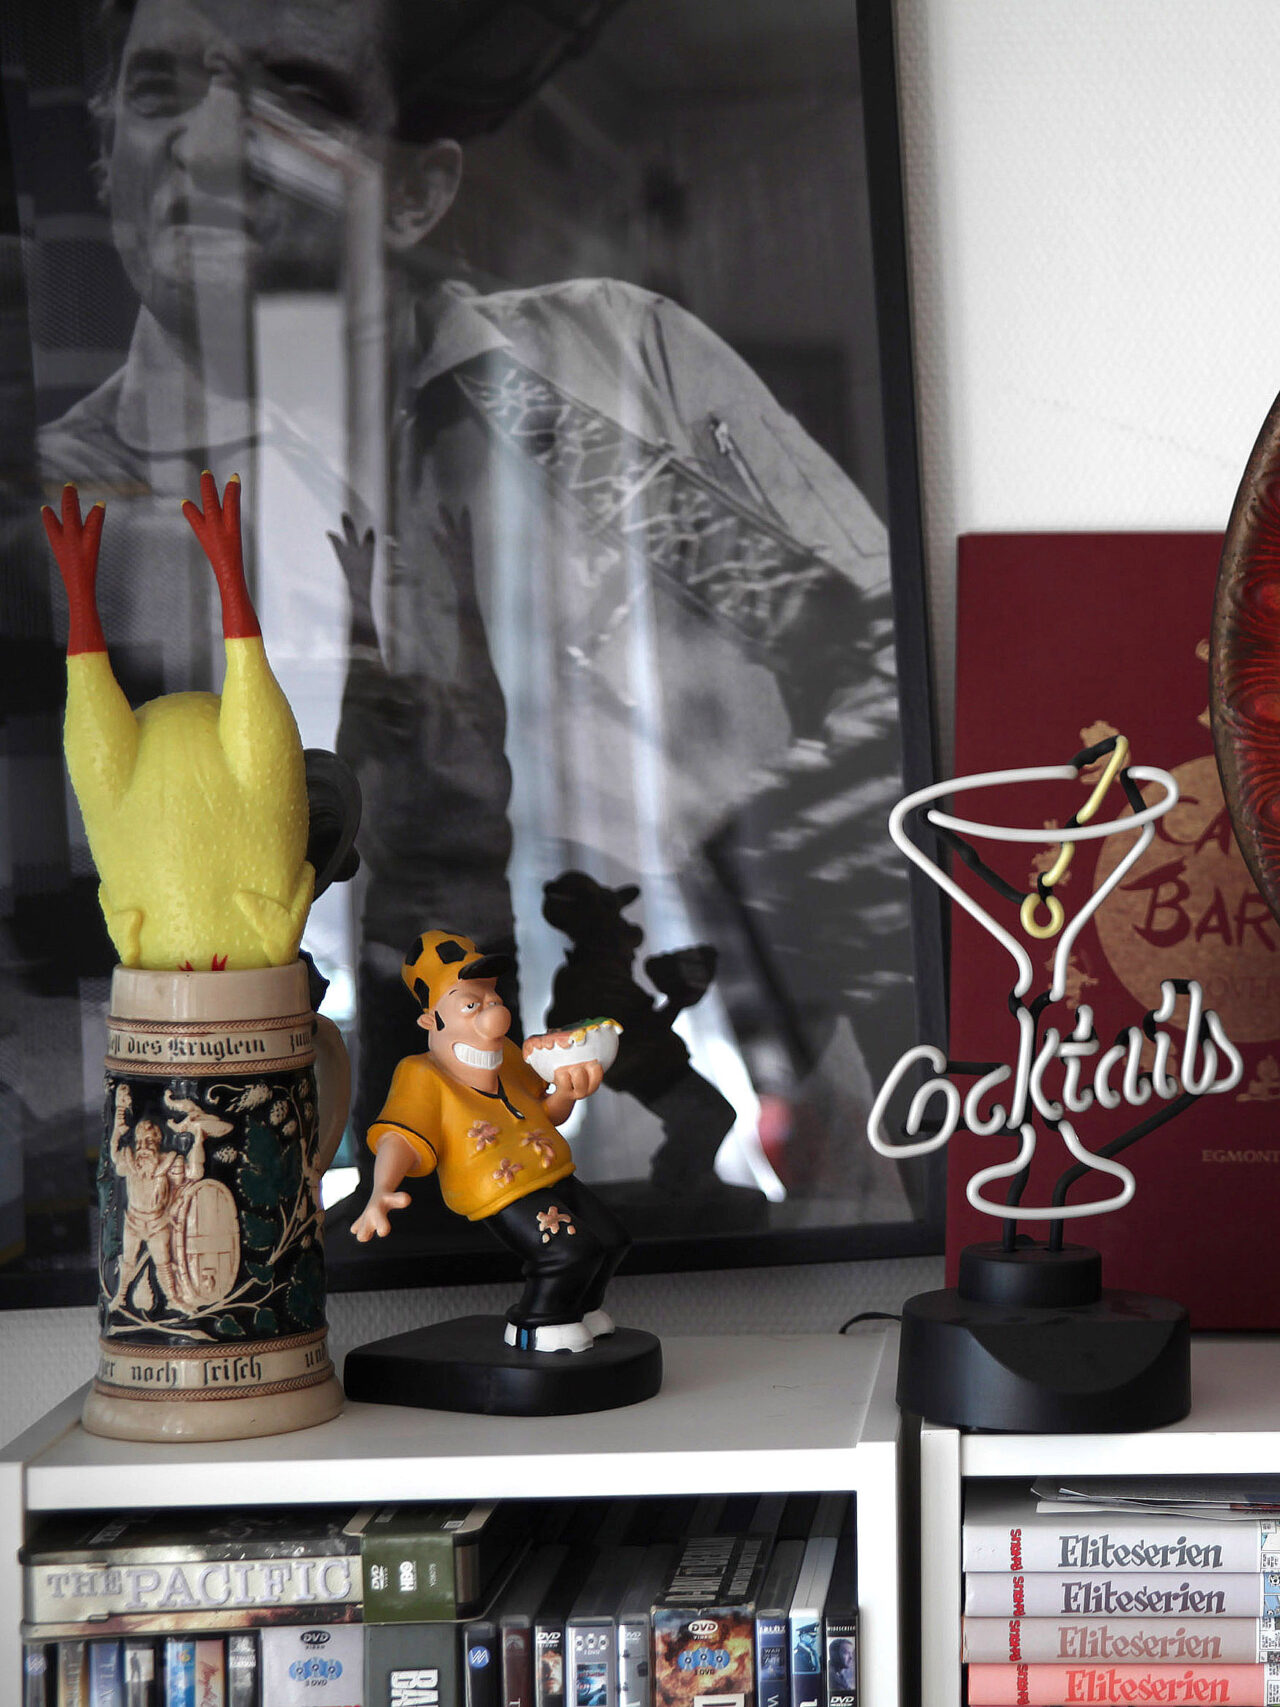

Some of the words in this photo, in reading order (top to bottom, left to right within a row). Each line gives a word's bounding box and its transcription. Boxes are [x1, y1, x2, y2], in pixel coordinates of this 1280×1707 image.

[1155, 795, 1233, 855] CA
[867, 978, 1243, 1158] Cocktails
[131, 1361, 178, 1387] noch
[1057, 1534, 1223, 1568] Eliteserien
[47, 1570, 123, 1599] THE
[124, 1558, 353, 1609] PACIFIC
[400, 1560, 414, 1592] HBO
[1060, 1580, 1226, 1614] Eliteserien
[303, 1631, 331, 1643] DVD
[692, 1622, 717, 1632] DVD
[1056, 1625, 1223, 1659] Eliteserien
[831, 1696, 855, 1706] DVD
[1064, 1668, 1231, 1703] Eliteserien
